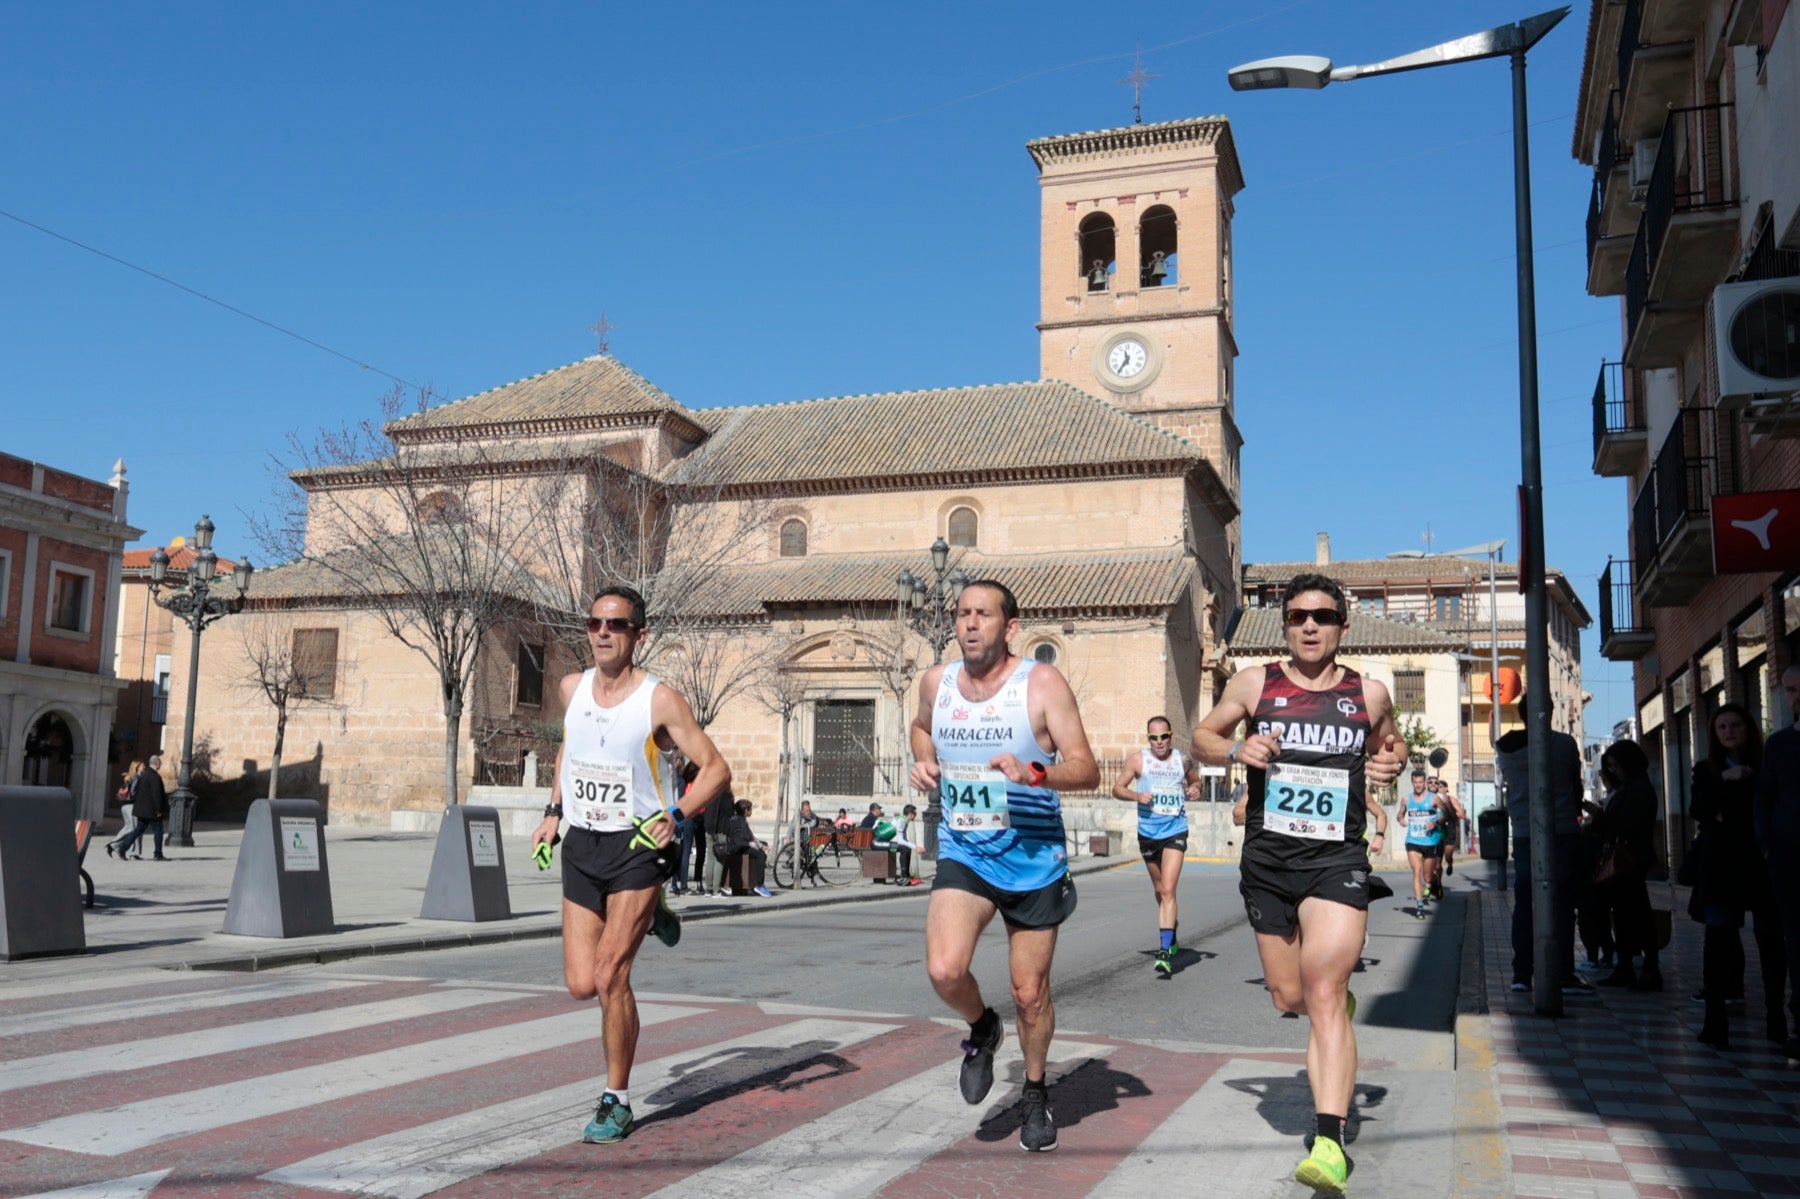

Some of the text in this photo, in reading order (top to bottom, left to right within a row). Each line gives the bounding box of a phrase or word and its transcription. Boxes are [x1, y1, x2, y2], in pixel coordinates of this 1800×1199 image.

[938, 727, 1013, 741] MARACENA
[1257, 721, 1365, 749] GRANADA
[1286, 767, 1300, 775] GRAN
[1300, 768, 1320, 777] PREMIO
[575, 778, 627, 803] 3072
[948, 783, 990, 808] 941
[1278, 786, 1334, 817] 226
